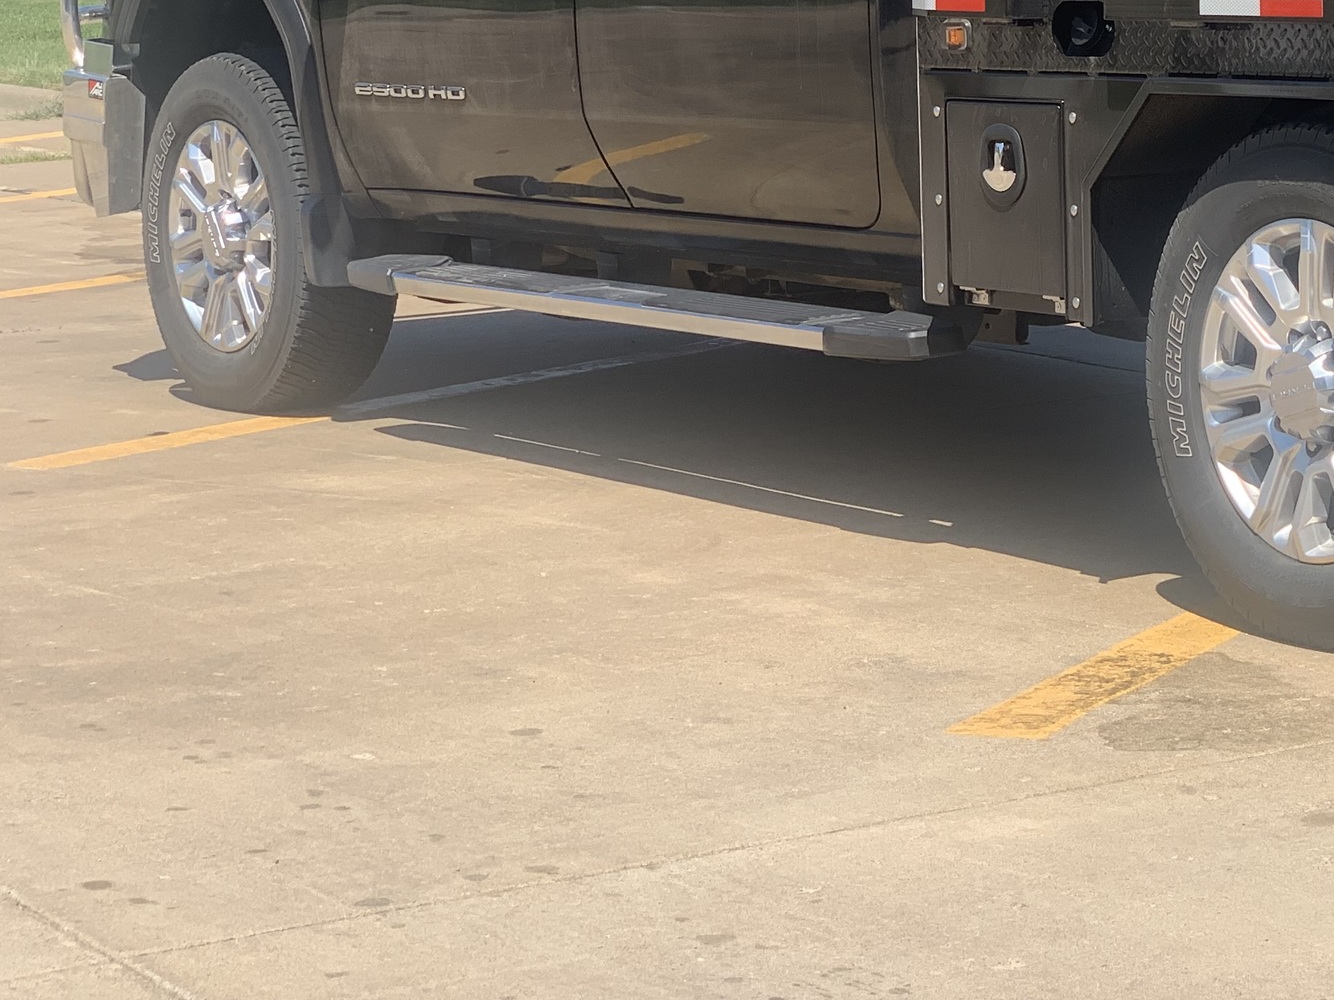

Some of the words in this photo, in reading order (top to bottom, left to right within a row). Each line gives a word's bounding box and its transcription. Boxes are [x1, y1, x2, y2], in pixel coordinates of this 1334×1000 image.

[354, 82, 425, 99] 2500
[428, 85, 466, 100] HD
[150, 122, 176, 263] MICHELIN
[1165, 241, 1209, 457] MICHELIN
